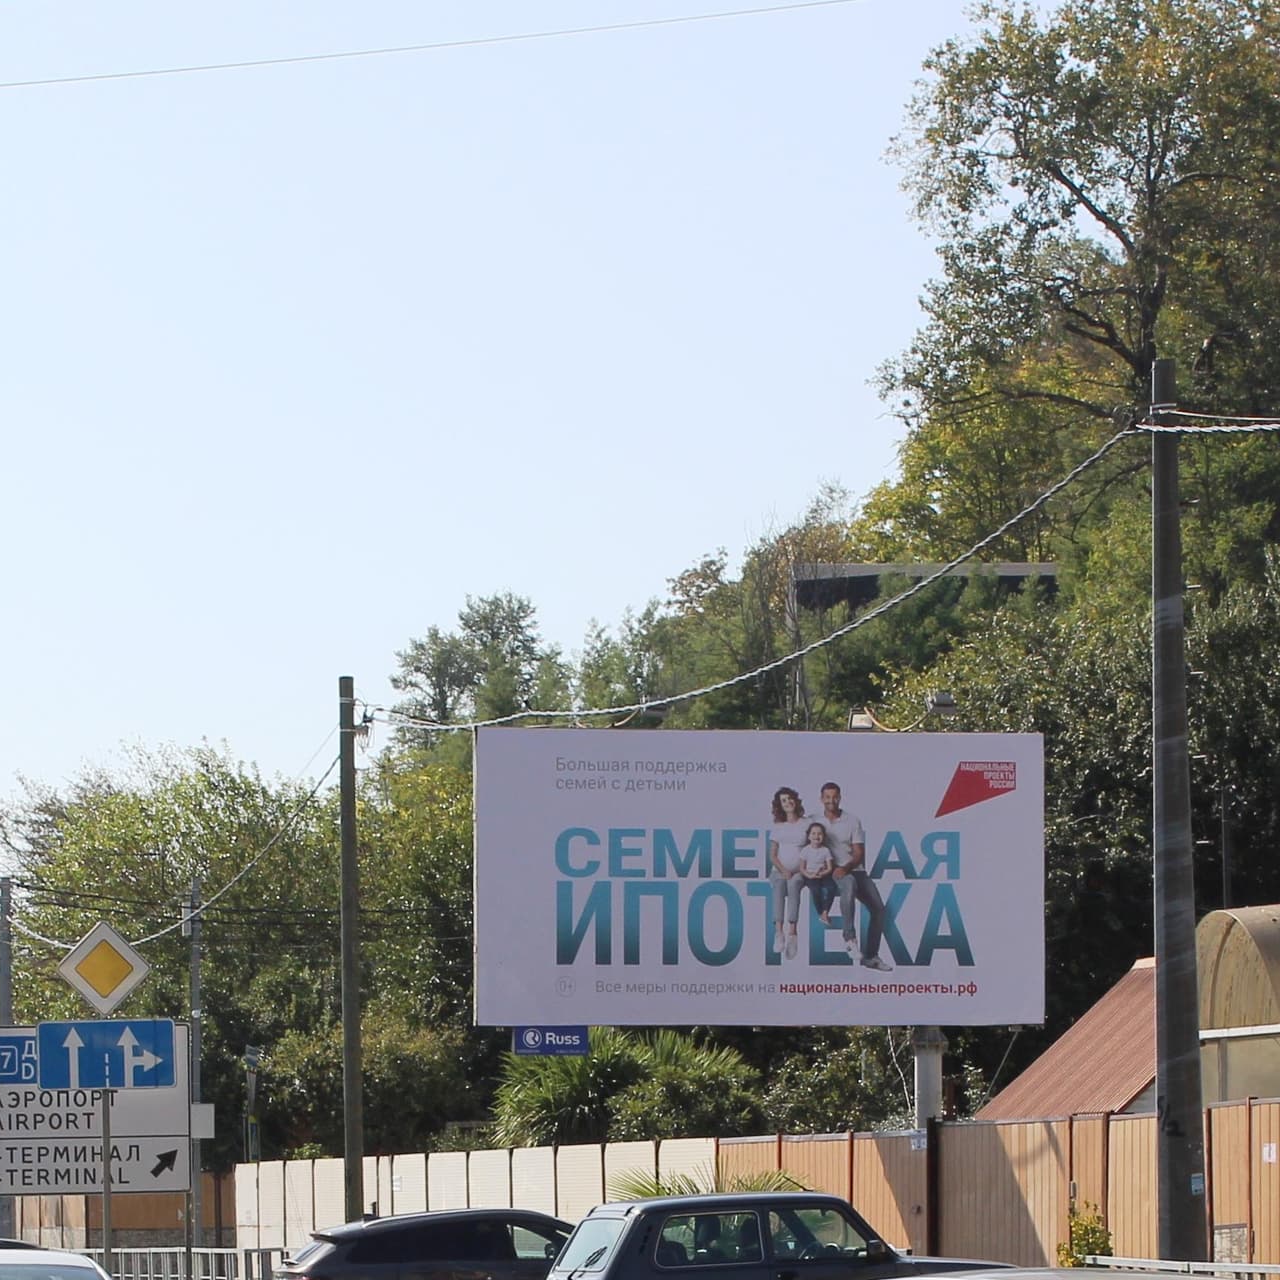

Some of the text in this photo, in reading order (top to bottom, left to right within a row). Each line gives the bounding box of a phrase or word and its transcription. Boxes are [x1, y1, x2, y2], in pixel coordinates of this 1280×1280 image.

[555, 756, 728, 776] Большая поддержка
[555, 776, 687, 793] семей с детьми
[554, 826, 961, 880] СЕМЕАЯ
[555, 880, 976, 967] ИПОТЕКА
[594, 980, 979, 998] Все меры поддержки на национальныепроекты.рф
[545, 1032, 581, 1046] Russ
